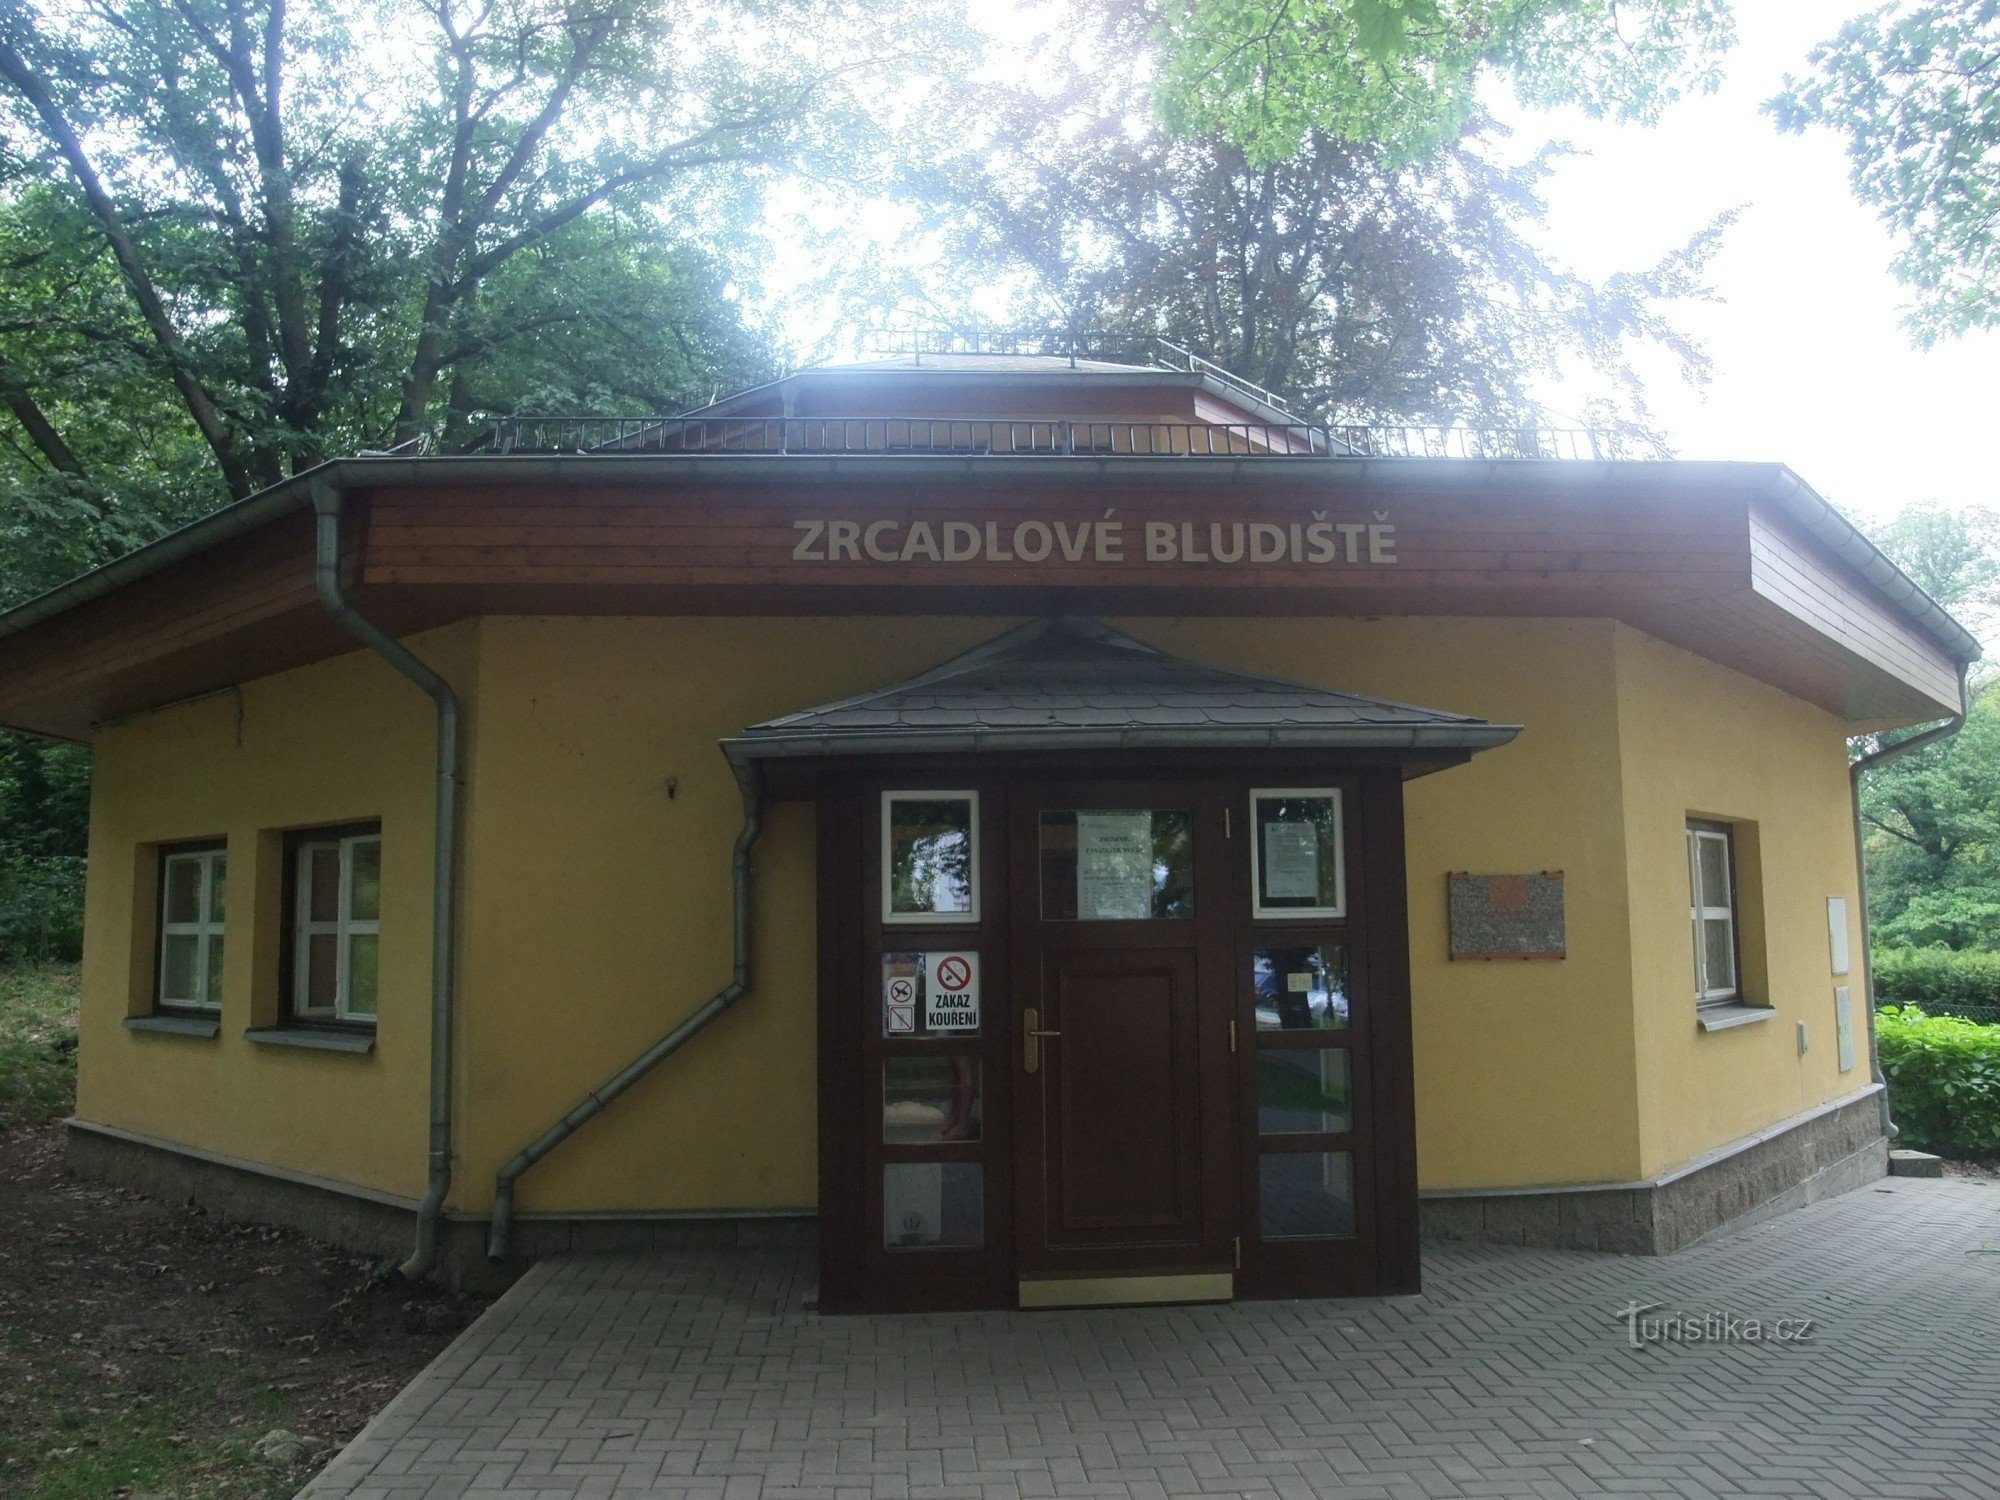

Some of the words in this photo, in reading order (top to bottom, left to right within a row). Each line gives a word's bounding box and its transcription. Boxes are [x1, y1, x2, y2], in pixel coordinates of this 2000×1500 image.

[793, 508, 1124, 562] ZRCADLOVÉ
[1145, 510, 1397, 564] BLUDIŠTĚ
[935, 992, 970, 1008] ZÁKAZ
[929, 1009, 977, 1026] KOUŘENÍ
